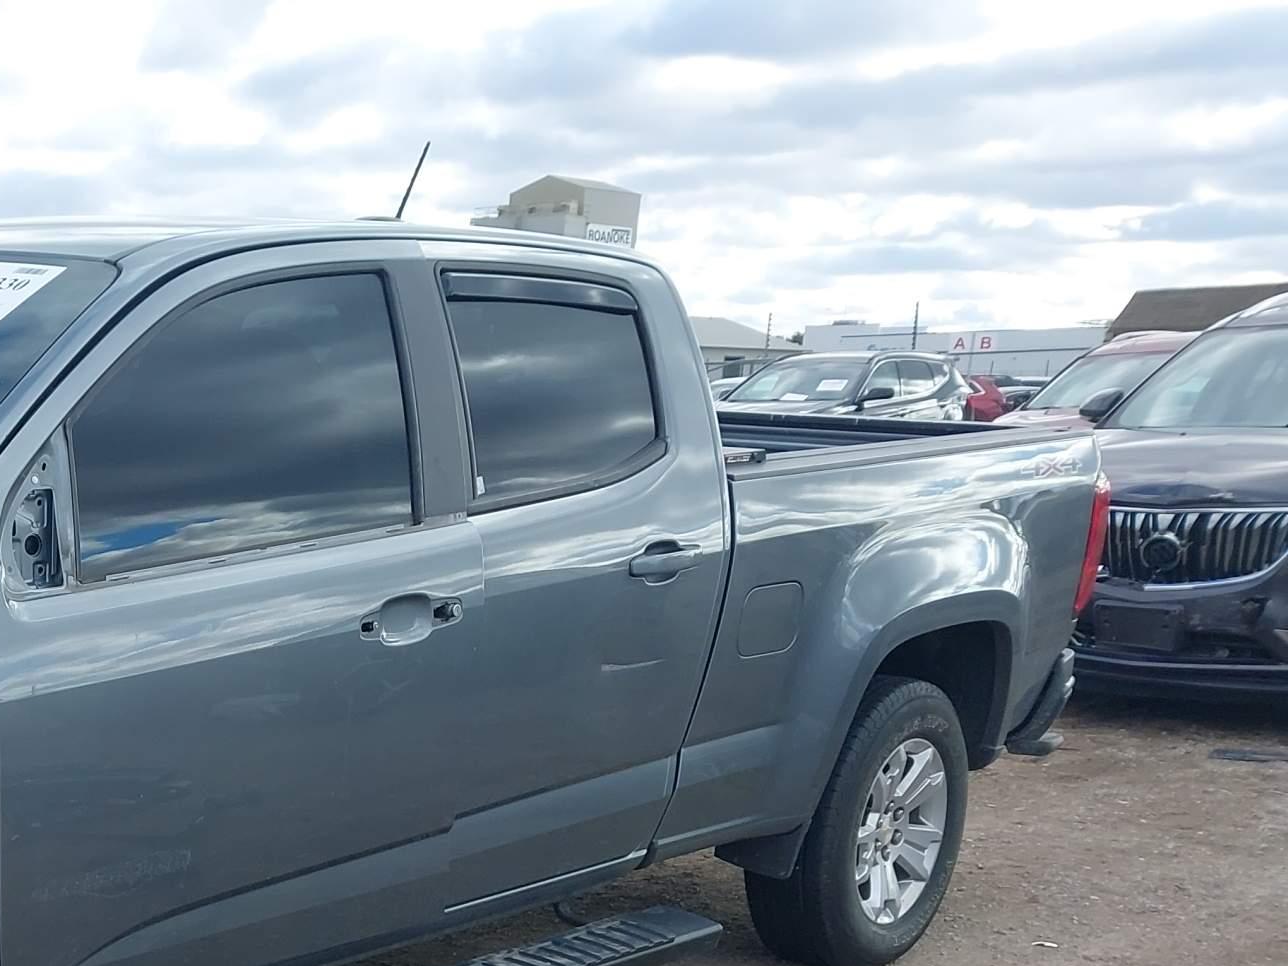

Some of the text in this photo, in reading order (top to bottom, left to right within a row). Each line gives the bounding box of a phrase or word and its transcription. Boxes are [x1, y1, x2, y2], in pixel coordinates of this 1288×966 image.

[588, 228, 630, 244] ROANOKE
[953, 336, 966, 350] A
[980, 336, 992, 350] B
